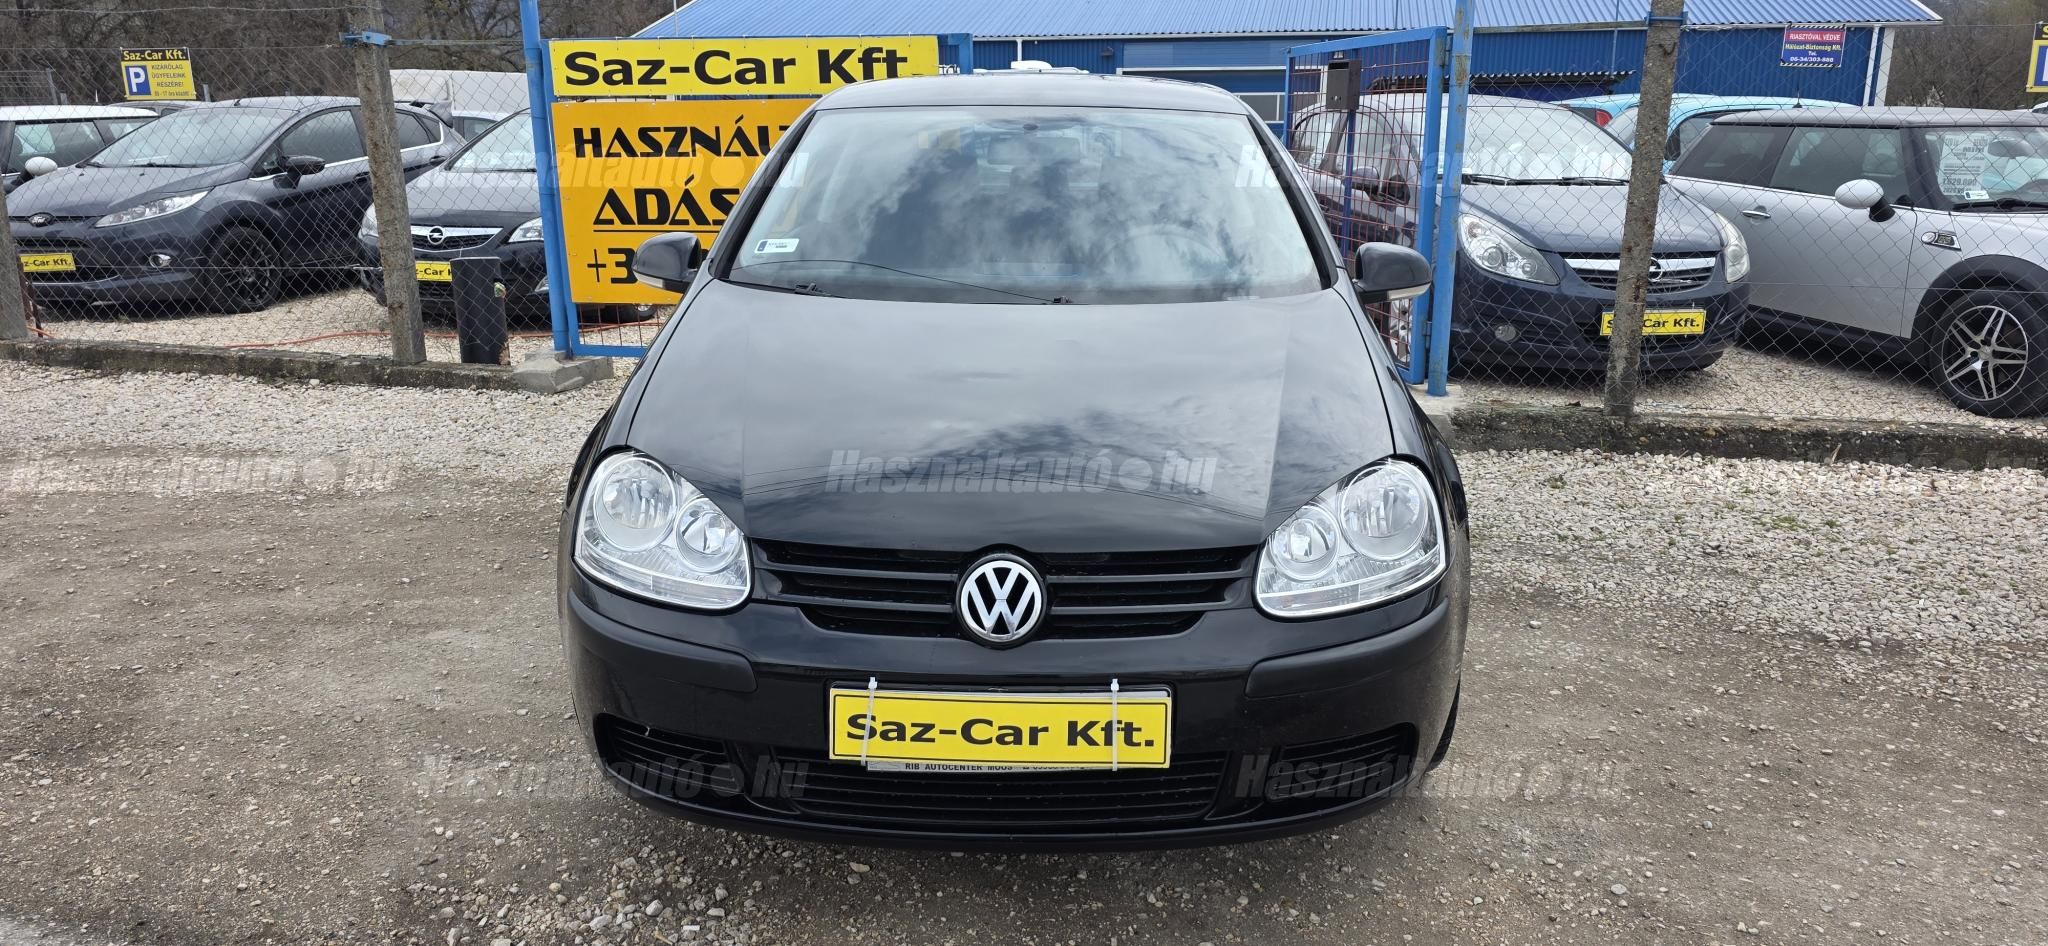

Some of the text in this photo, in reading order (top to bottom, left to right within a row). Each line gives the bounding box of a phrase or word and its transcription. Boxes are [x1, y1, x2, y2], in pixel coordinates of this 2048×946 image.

[1789, 32, 1841, 41] RIASZTÓVAL VÉDVE
[123, 49, 186, 60] Saz-Car Kft.
[564, 46, 908, 87] Saz-Car Kft
[573, 114, 791, 158] HASZNÁL
[23, 259, 50, 267] z-Car
[416, 267, 444, 276] -Car
[1673, 318, 1700, 328] Kft.
[846, 713, 1155, 747] Saz-Car Kft.
[924, 763, 983, 771] AUTOCENTER
